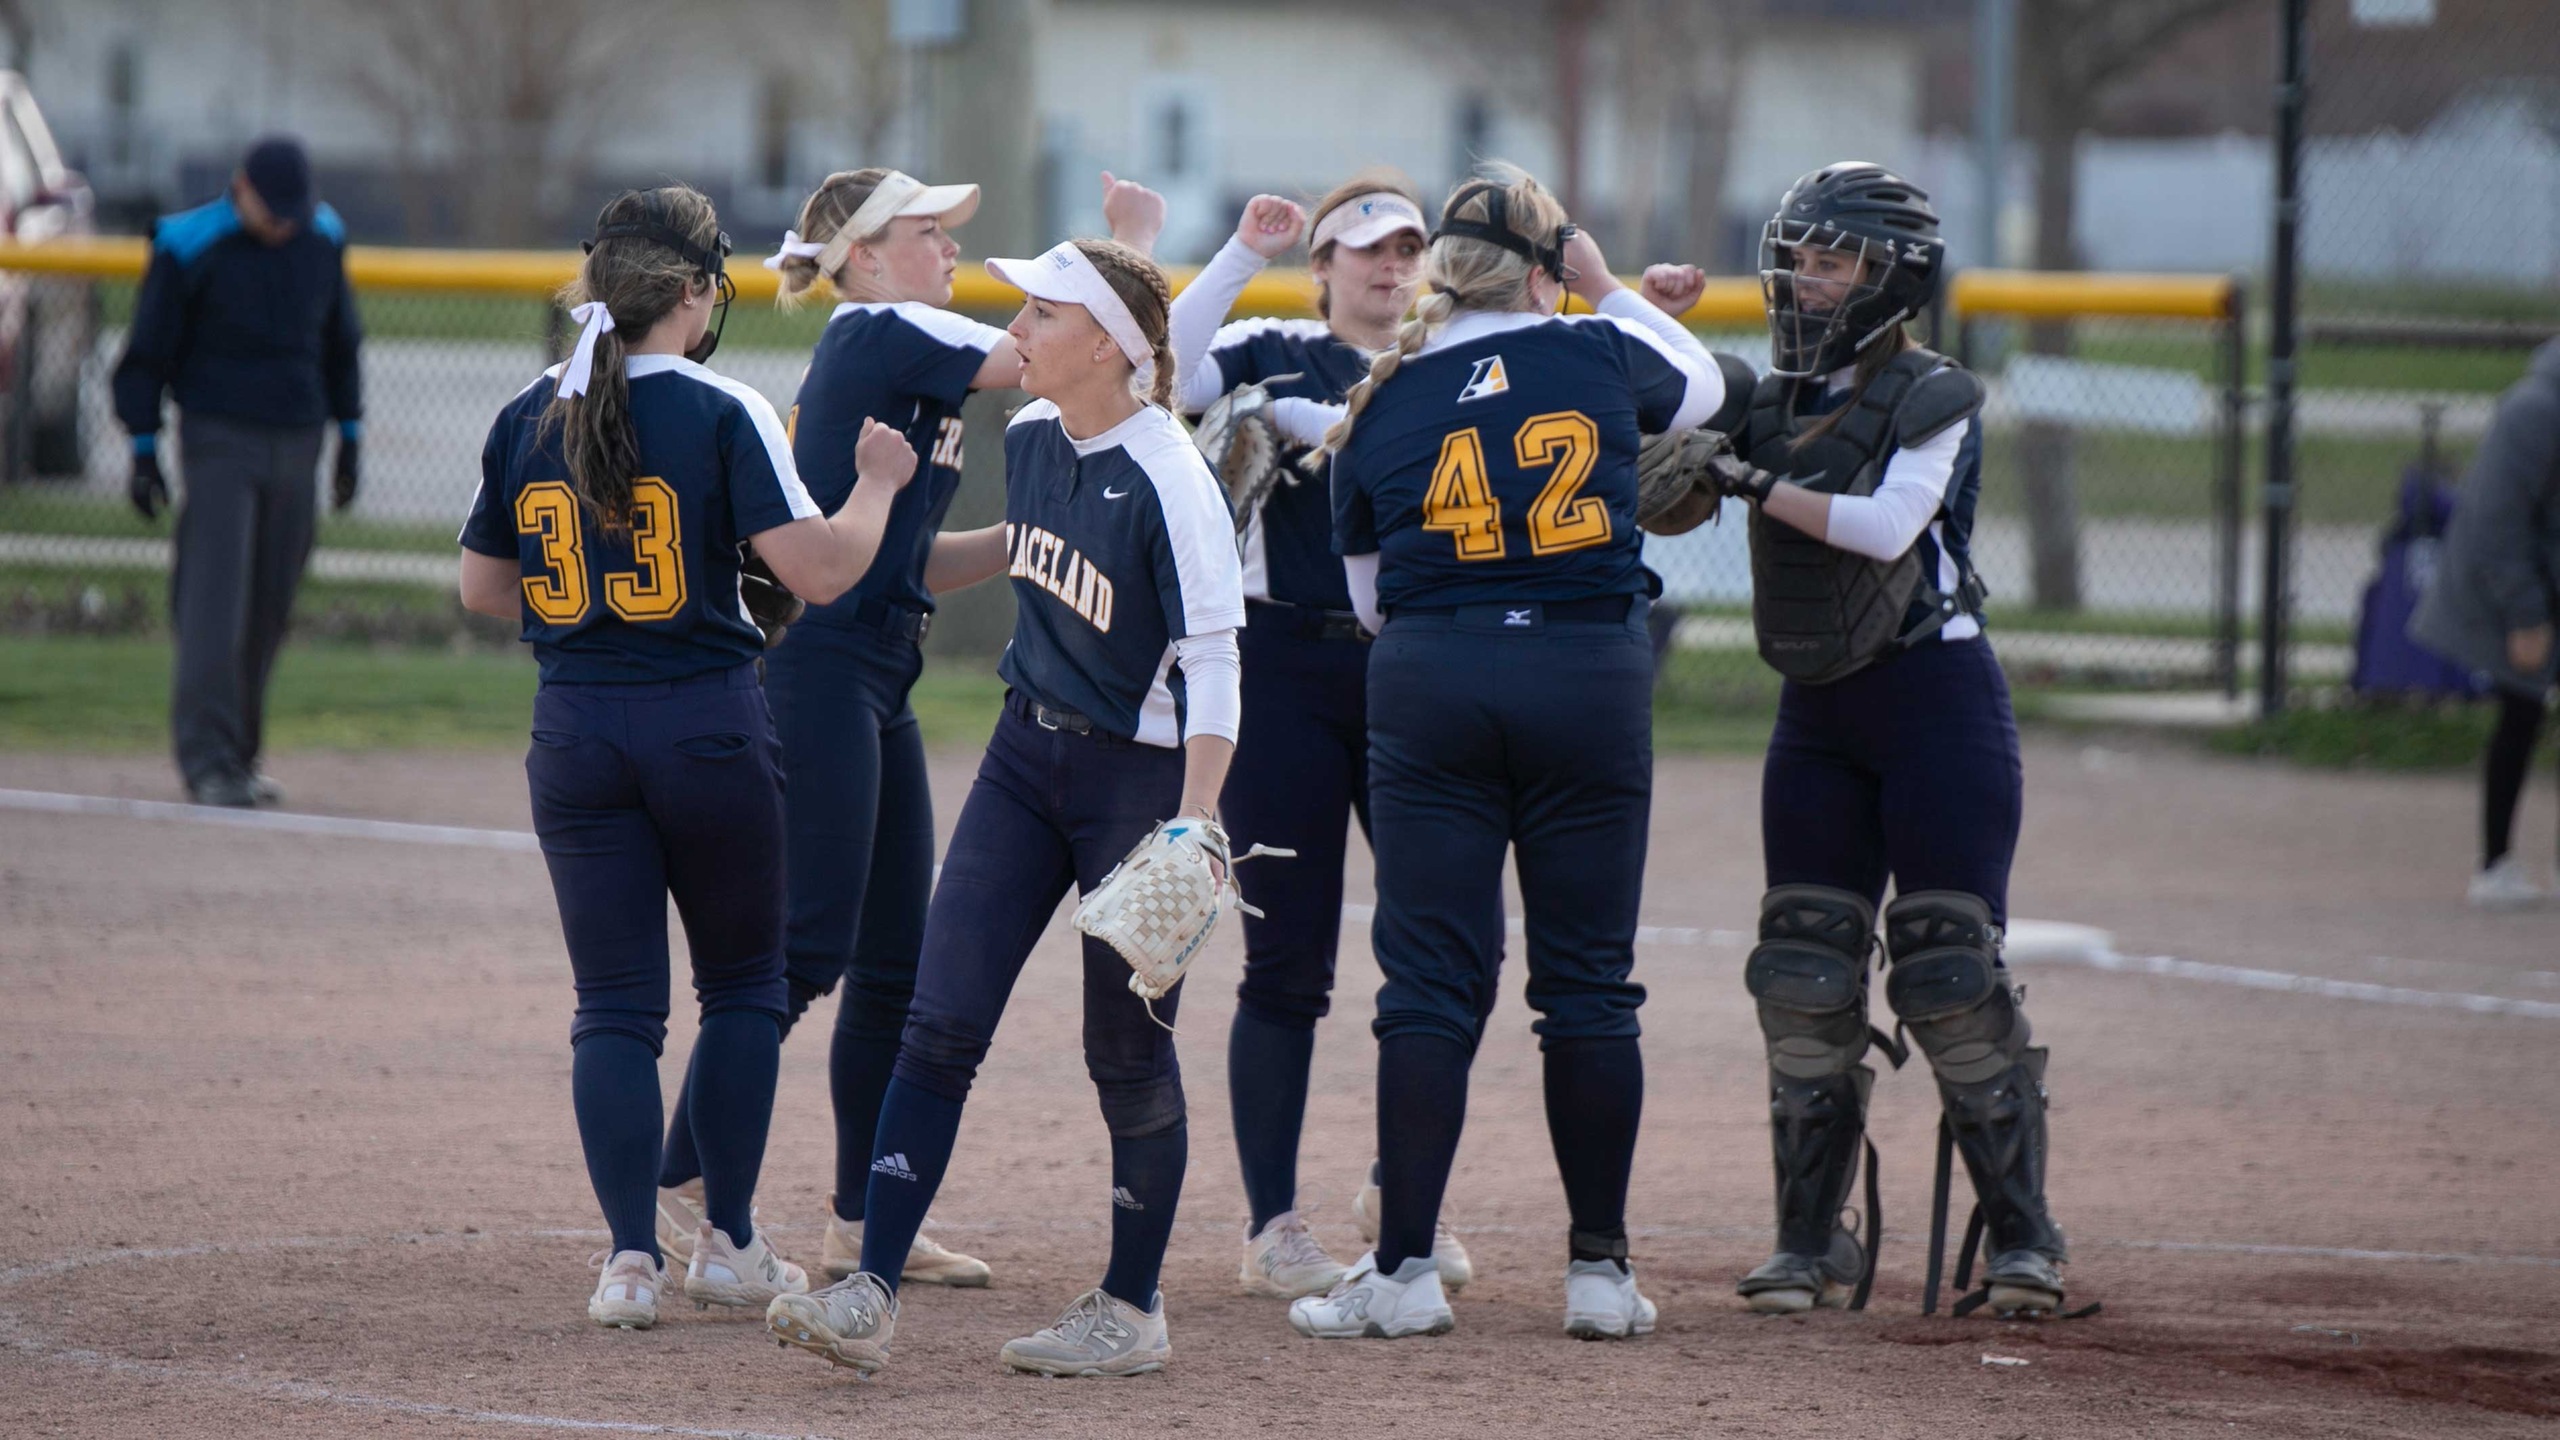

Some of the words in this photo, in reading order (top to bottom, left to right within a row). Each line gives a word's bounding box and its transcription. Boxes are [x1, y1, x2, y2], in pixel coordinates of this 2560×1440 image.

[1422, 410, 1612, 561] 42
[515, 476, 687, 625] 33
[1174, 908, 1218, 965] EASTON
[870, 1161, 918, 1182] adidas
